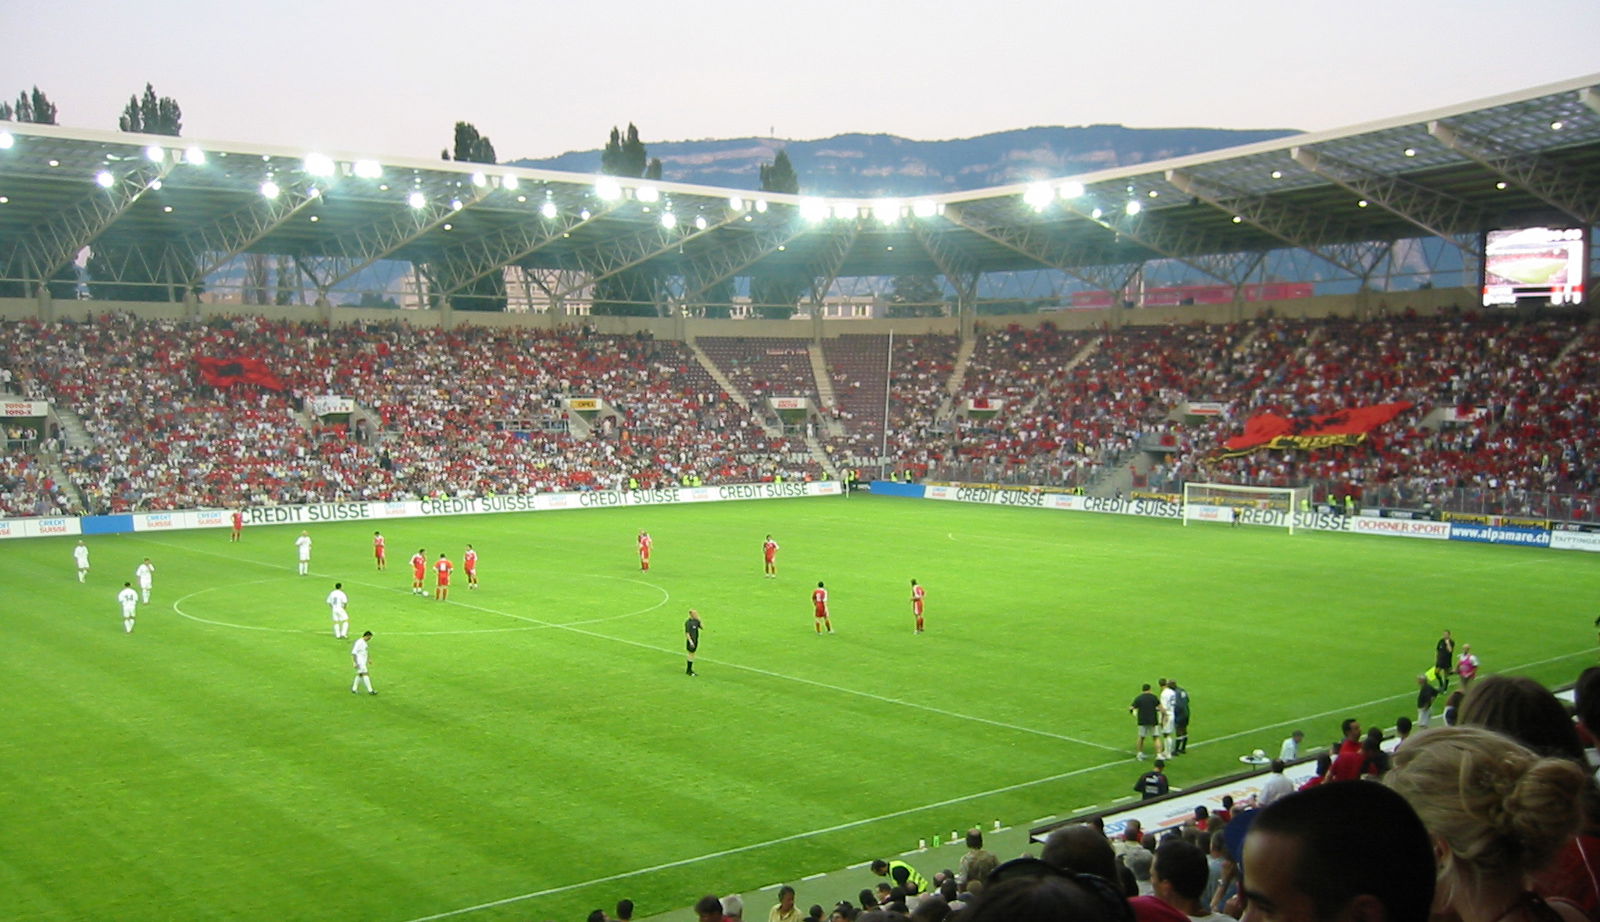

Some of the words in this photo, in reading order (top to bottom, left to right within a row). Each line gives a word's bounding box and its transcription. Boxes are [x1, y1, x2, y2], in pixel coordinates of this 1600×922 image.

[580, 491, 629, 507] CREDIT
[633, 489, 680, 504] SUISSE
[719, 485, 763, 500] CREDIT
[767, 483, 809, 497] SUISSE
[956, 487, 998, 503] CREDIT
[1001, 491, 1045, 507] SUISSE
[240, 507, 302, 524] CREDIT
[308, 503, 370, 521] SUISSE
[421, 499, 478, 515] CREDIT
[482, 496, 536, 512] SUISSE
[1084, 496, 1133, 513] CREDIT
[1135, 500, 1185, 517] SUISSE
[1242, 508, 1286, 525] REDIT
[1293, 511, 1350, 530] SUISSE
[1358, 520, 1409, 531] OCHSNER
[1411, 523, 1448, 534] SPORT
[1452, 527, 1549, 544] www.alpamare.ch
